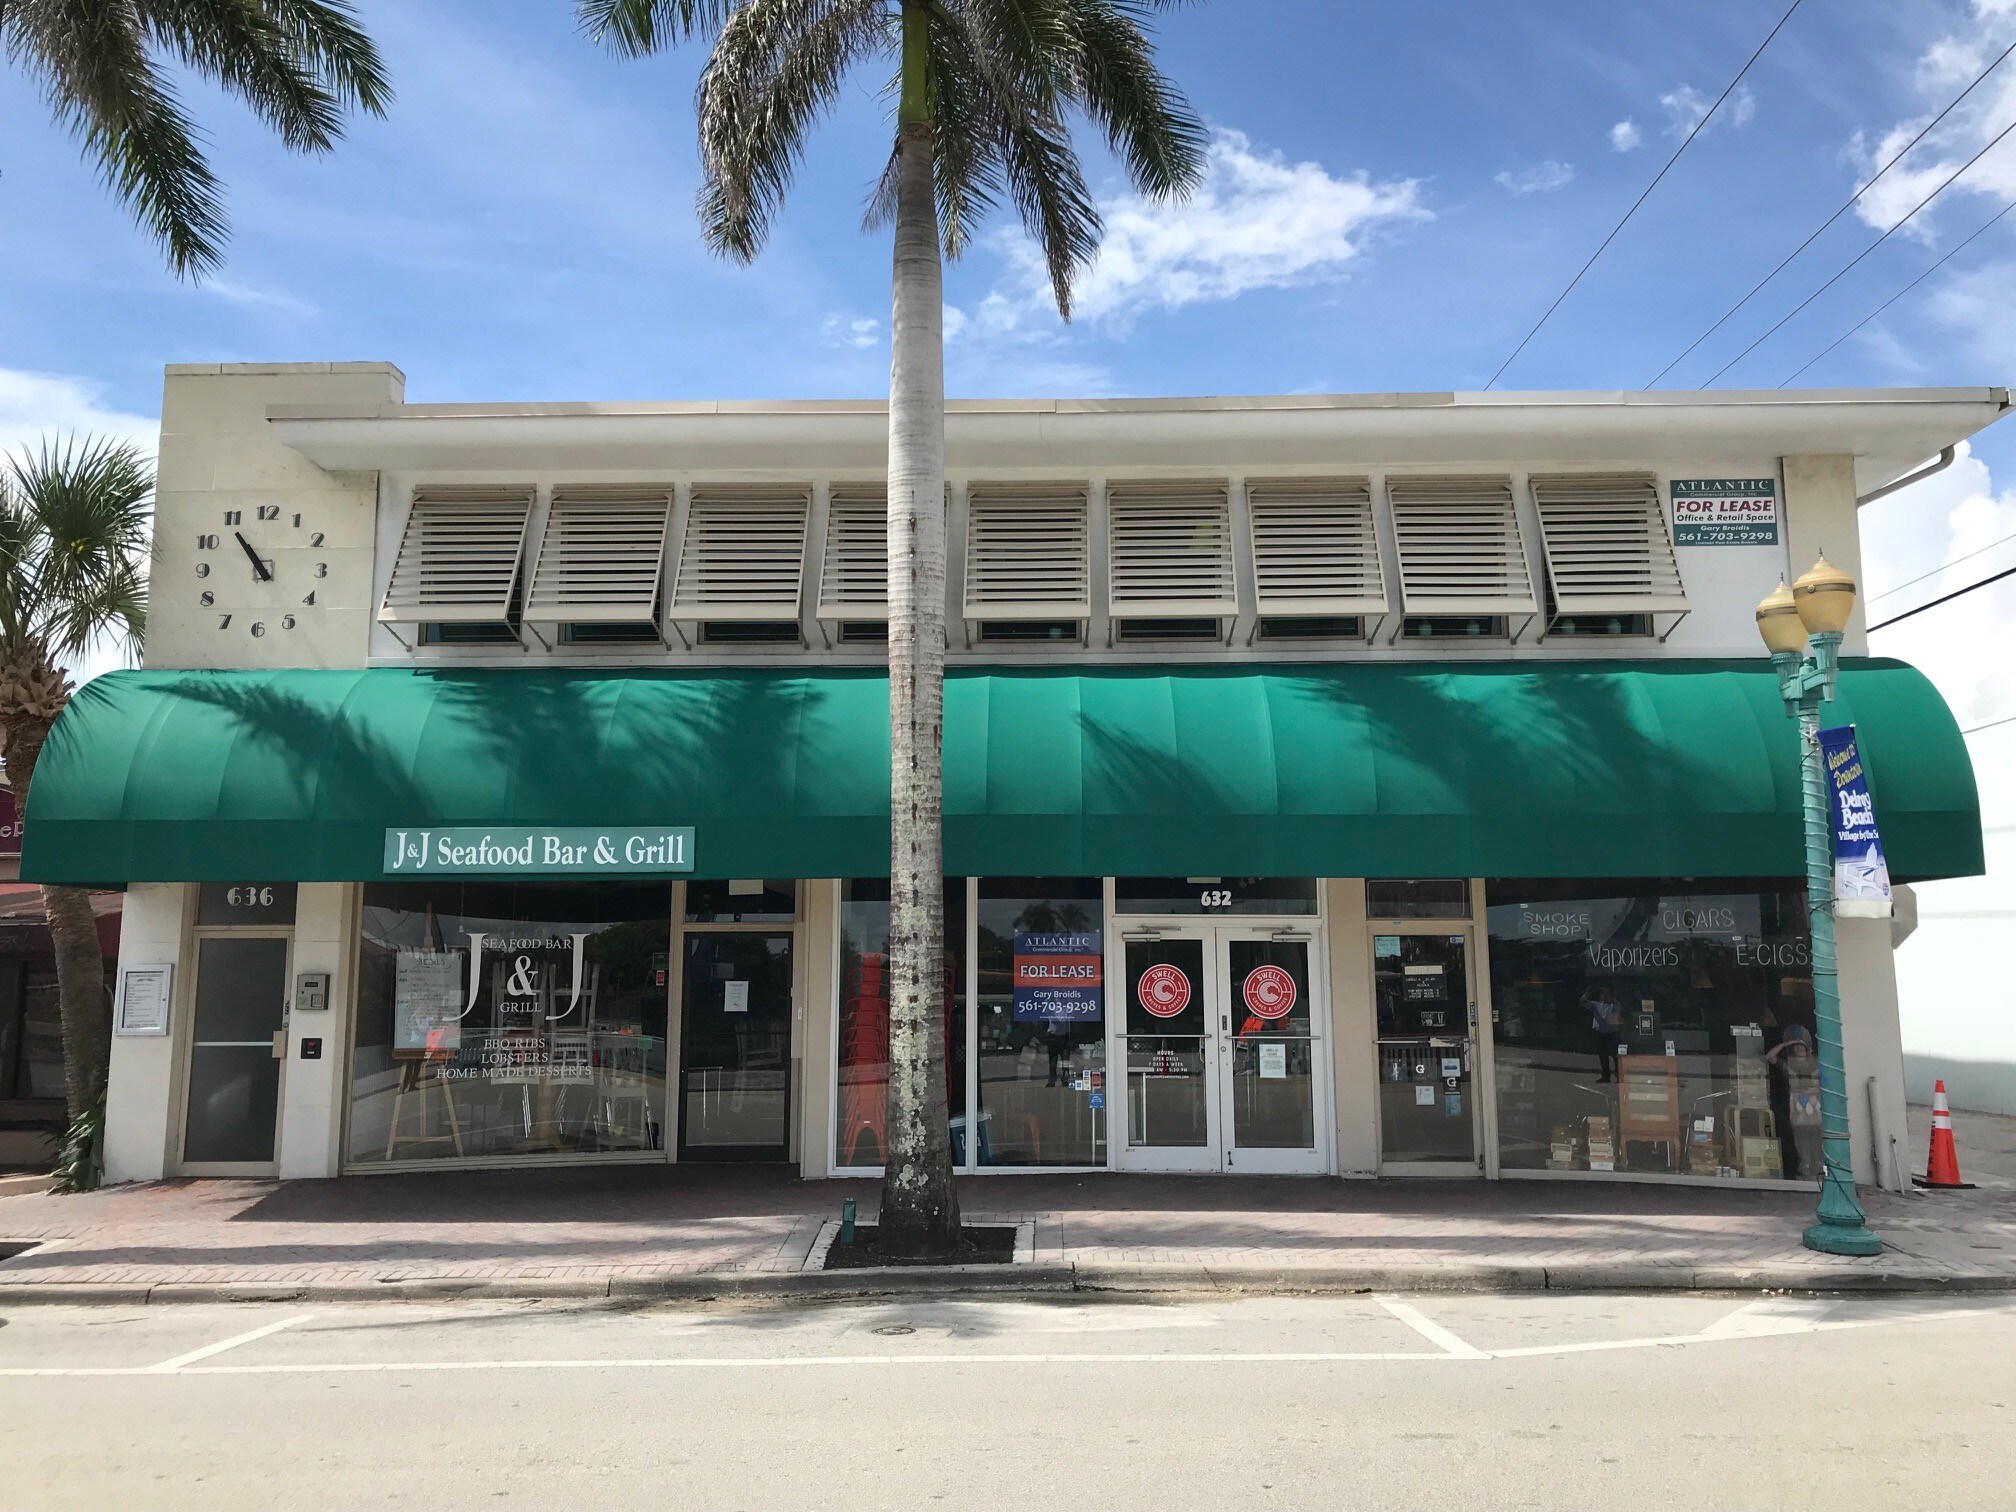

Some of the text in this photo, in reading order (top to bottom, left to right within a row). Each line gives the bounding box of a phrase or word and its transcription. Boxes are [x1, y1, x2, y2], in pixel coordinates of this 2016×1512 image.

[1677, 480, 1769, 491] ATLANTIC
[256, 504, 280, 521] 12
[1676, 500, 1772, 513] FOR LEASE
[223, 510, 242, 526] 11
[292, 513, 302, 528] 1
[1677, 514, 1704, 522] Office
[1746, 514, 1774, 522] Space
[196, 534, 220, 550] 10
[310, 532, 325, 548] 2
[1678, 532, 1773, 541] 561-703-9298
[196, 562, 210, 578] 9
[314, 562, 328, 578] 3
[200, 590, 215, 606] 8
[302, 590, 316, 606] 4
[218, 614, 232, 630] 7
[282, 614, 296, 630] 5
[250, 622, 266, 638] 6
[1841, 806, 1875, 830] Beach
[1838, 830, 1859, 842] Village
[392, 832, 685, 869] J&J Seafood Bar & Grill
[226, 886, 274, 907] 636
[1200, 890, 1232, 907] 632
[1522, 911, 1591, 925] SMOKE
[1662, 908, 1734, 930] CIGARS
[1529, 924, 1583, 936] SHOP
[481, 938, 573, 950] SEAFOOD BAR
[1025, 937, 1090, 946] ATLANTIC
[1588, 943, 1679, 973] Vaporizers
[1736, 943, 1808, 966] E-CIGS
[442, 933, 489, 1022] J
[507, 955, 539, 997] &
[545, 933, 591, 1022] J
[1020, 965, 1095, 978] FOR LEASE
[1151, 970, 1176, 980] SWELL
[1256, 971, 1281, 982] SWELL
[1033, 990, 1082, 1000] Gary Broidis
[500, 1002, 543, 1013] GRILL
[1018, 999, 1097, 1014] 561-703-9298
[484, 1038, 546, 1050] BBQ RIBS
[481, 1052, 549, 1064] LOBSTERS
[436, 1065, 592, 1079] HOME MADE DESSERTS
